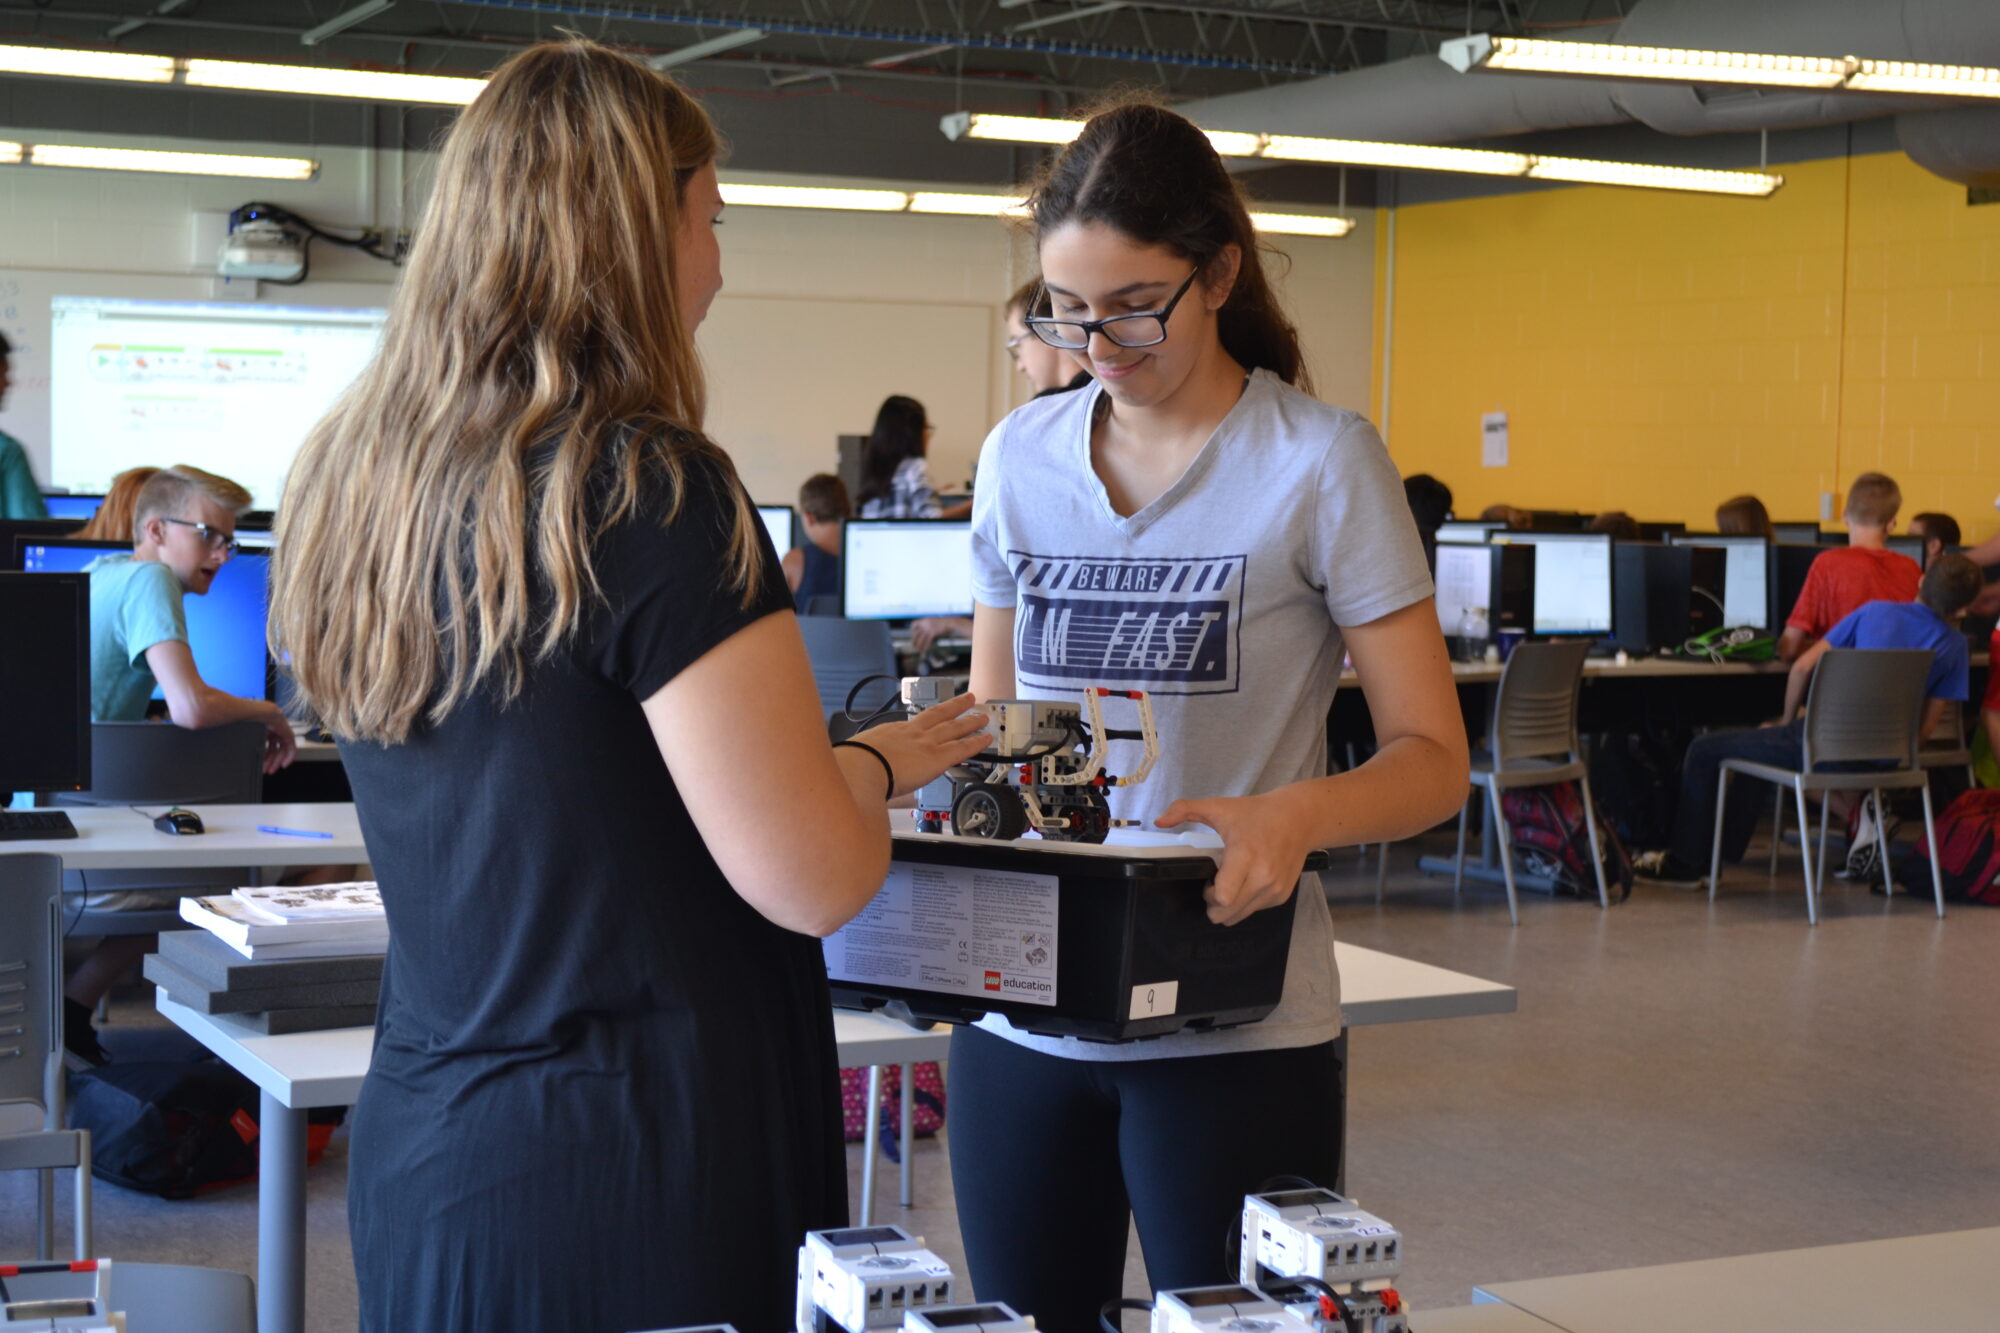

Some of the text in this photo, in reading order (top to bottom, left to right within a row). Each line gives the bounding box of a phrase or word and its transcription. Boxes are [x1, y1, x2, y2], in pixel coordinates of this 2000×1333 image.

[1076, 565, 1162, 591] BEWARE
[1102, 611, 1222, 671] FAST.
[1003, 977, 1052, 992] education
